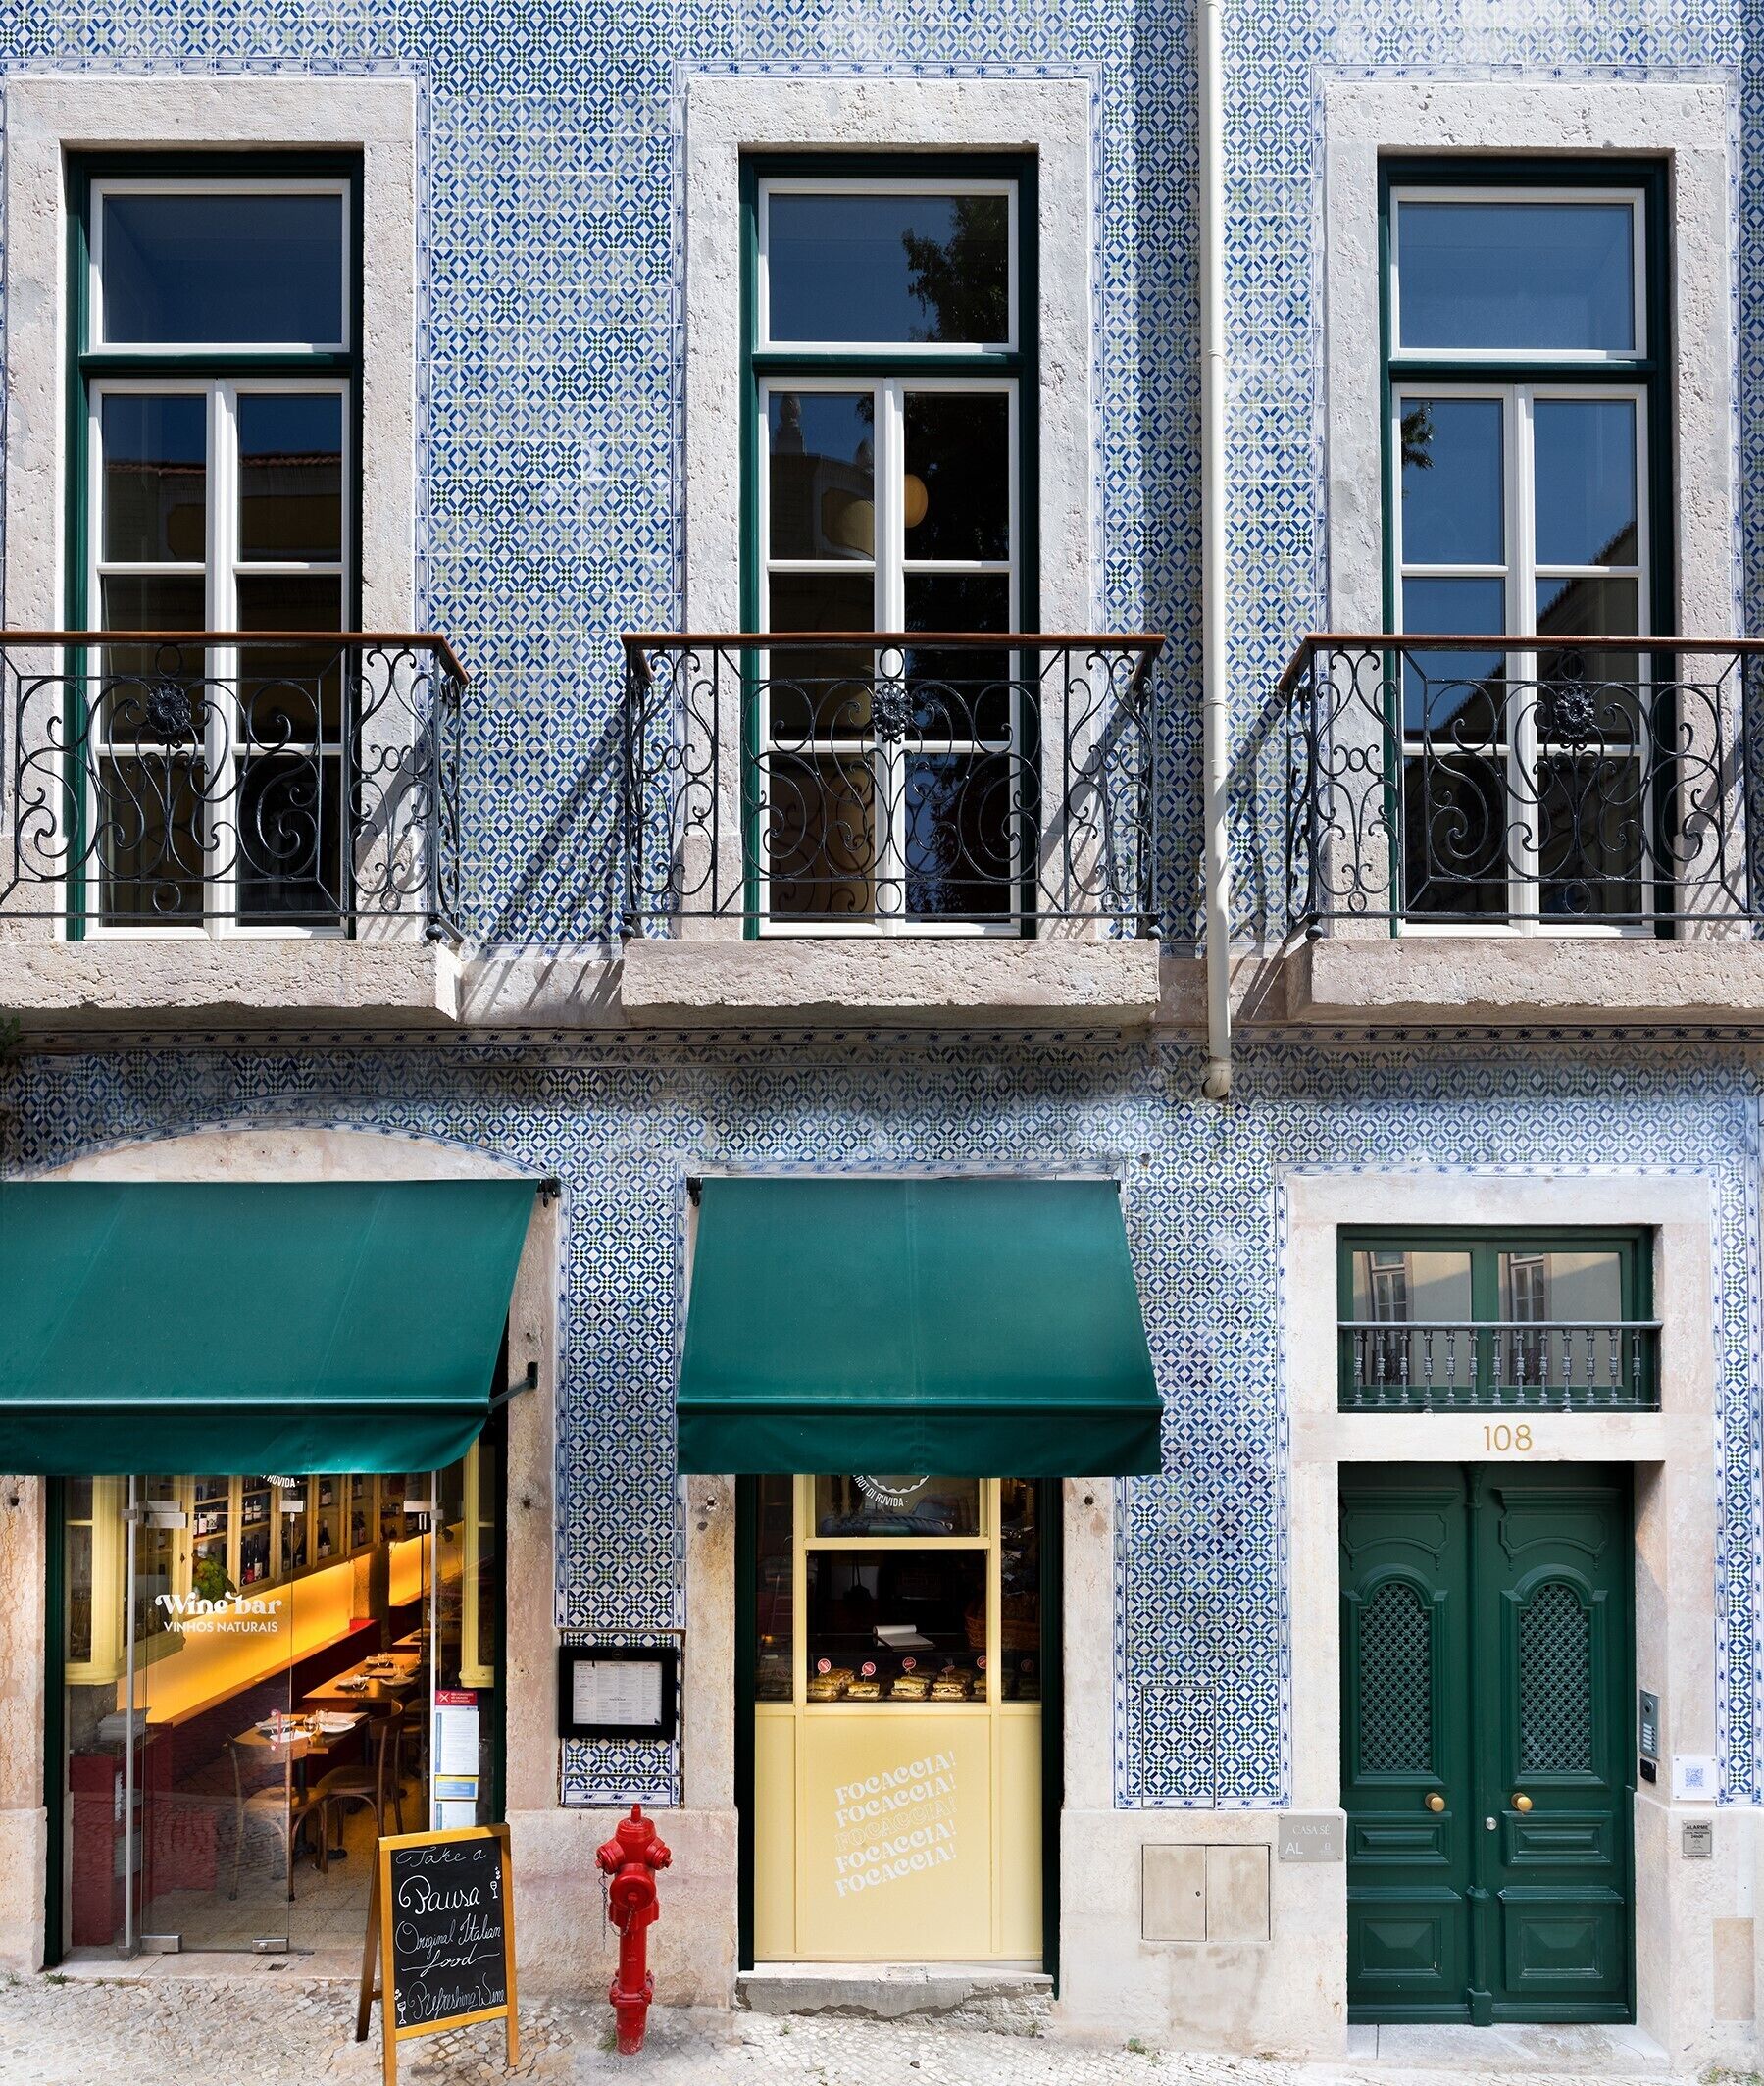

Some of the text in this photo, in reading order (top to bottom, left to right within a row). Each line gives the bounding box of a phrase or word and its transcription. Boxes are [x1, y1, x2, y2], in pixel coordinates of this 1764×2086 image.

[1484, 1424, 1533, 1451] 108
[866, 1488, 877, 1499] DI
[875, 1493, 904, 1507] RUVIDA
[154, 1591, 282, 1615] Wine bar
[163, 1621, 278, 1633] VINHOS NATURAIS
[834, 1750, 957, 1806] FOCACCIA!
[834, 1773, 957, 1829] FOCACCIA!
[834, 1819, 957, 1874] FOCACCIA!
[1292, 1824, 1318, 1835] CASA
[395, 1846, 486, 1868] Take a
[1285, 1842, 1304, 1855] AL
[834, 1843, 957, 1898] FOCACCIA!
[398, 1874, 480, 1915] Pausa
[395, 1913, 501, 1960] Original Italian
[401, 1944, 500, 1978] food
[407, 1972, 505, 2020] Refreshing Wine
